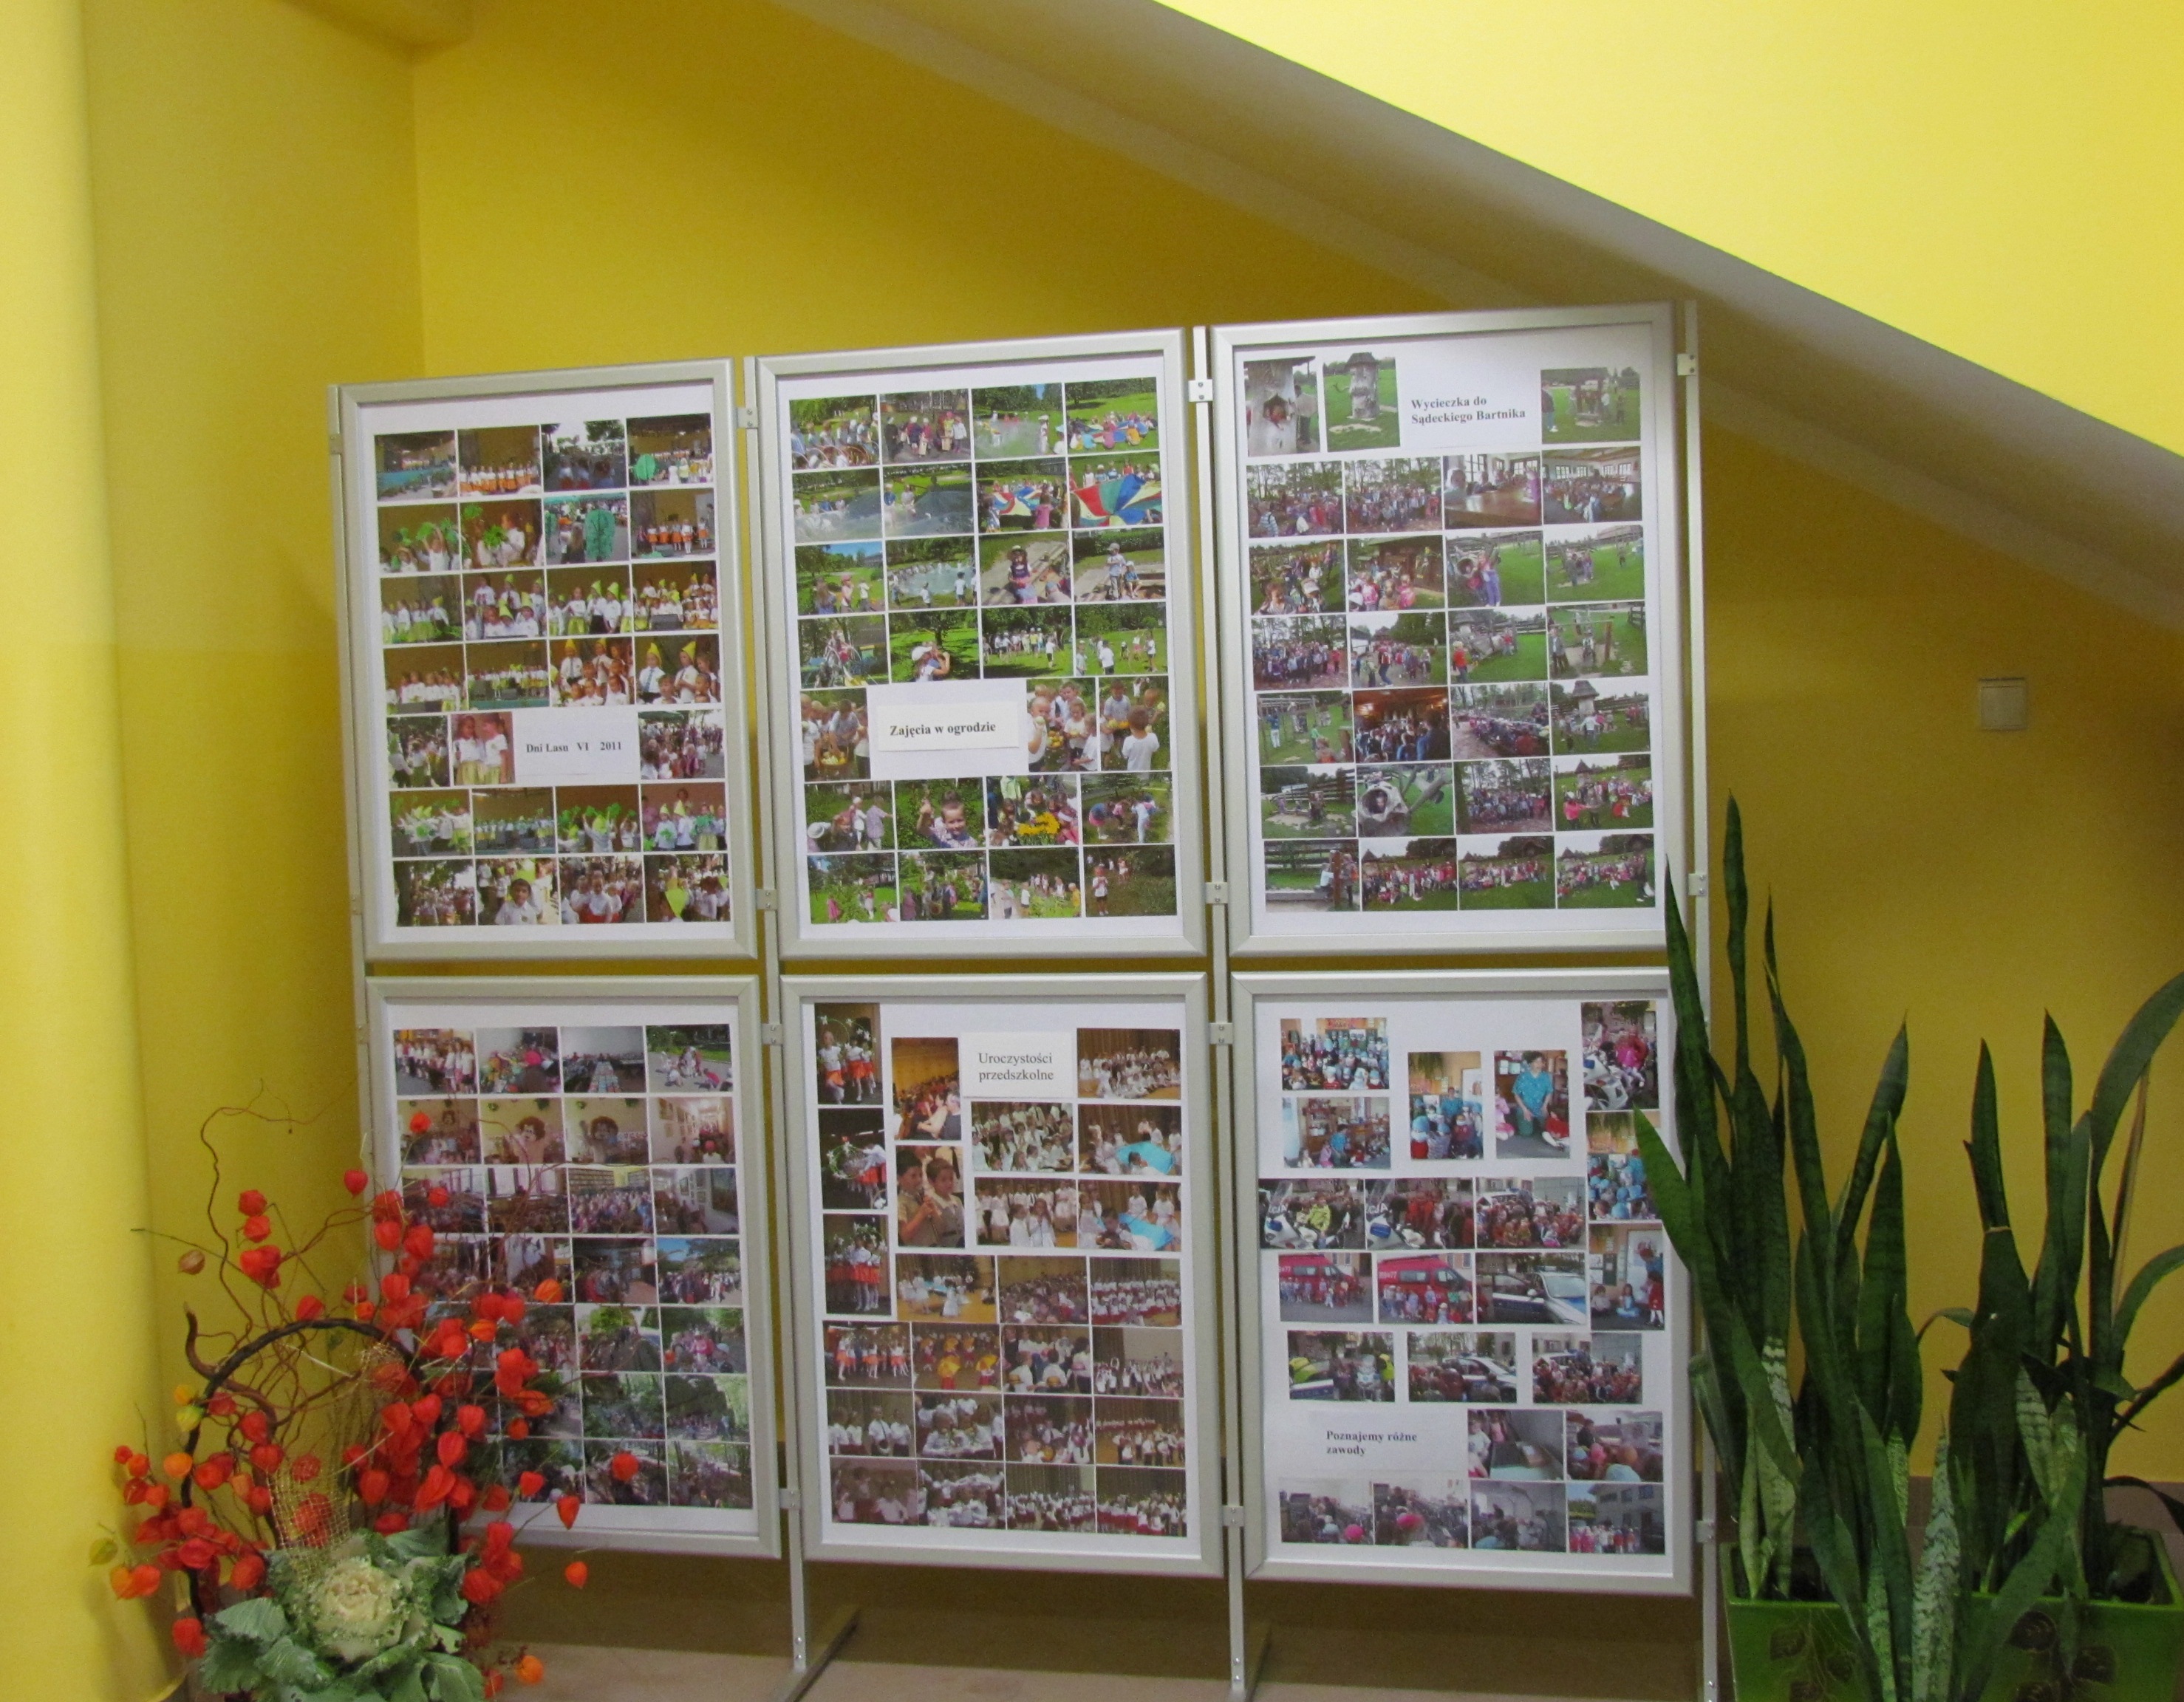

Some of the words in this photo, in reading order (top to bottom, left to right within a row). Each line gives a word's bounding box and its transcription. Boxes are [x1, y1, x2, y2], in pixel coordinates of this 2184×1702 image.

[1411, 397, 1470, 411] Wycieczka
[1473, 396, 1487, 406] do
[1411, 412, 1473, 426] Sądeckiego
[1476, 409, 1526, 420] Bartnika
[890, 724, 931, 738] Zajęcia
[947, 722, 996, 735] ogrodzie
[526, 743, 543, 753] Dni
[546, 743, 569, 752] Lasu
[576, 742, 589, 751] VI
[600, 741, 621, 751] 2011
[979, 1052, 1052, 1066] Uroczystości
[979, 1069, 1054, 1083] przedszkolne
[1326, 1431, 1384, 1443] Poznajemy
[1388, 1432, 1418, 1441] różne
[1326, 1445, 1365, 1457] zawody
